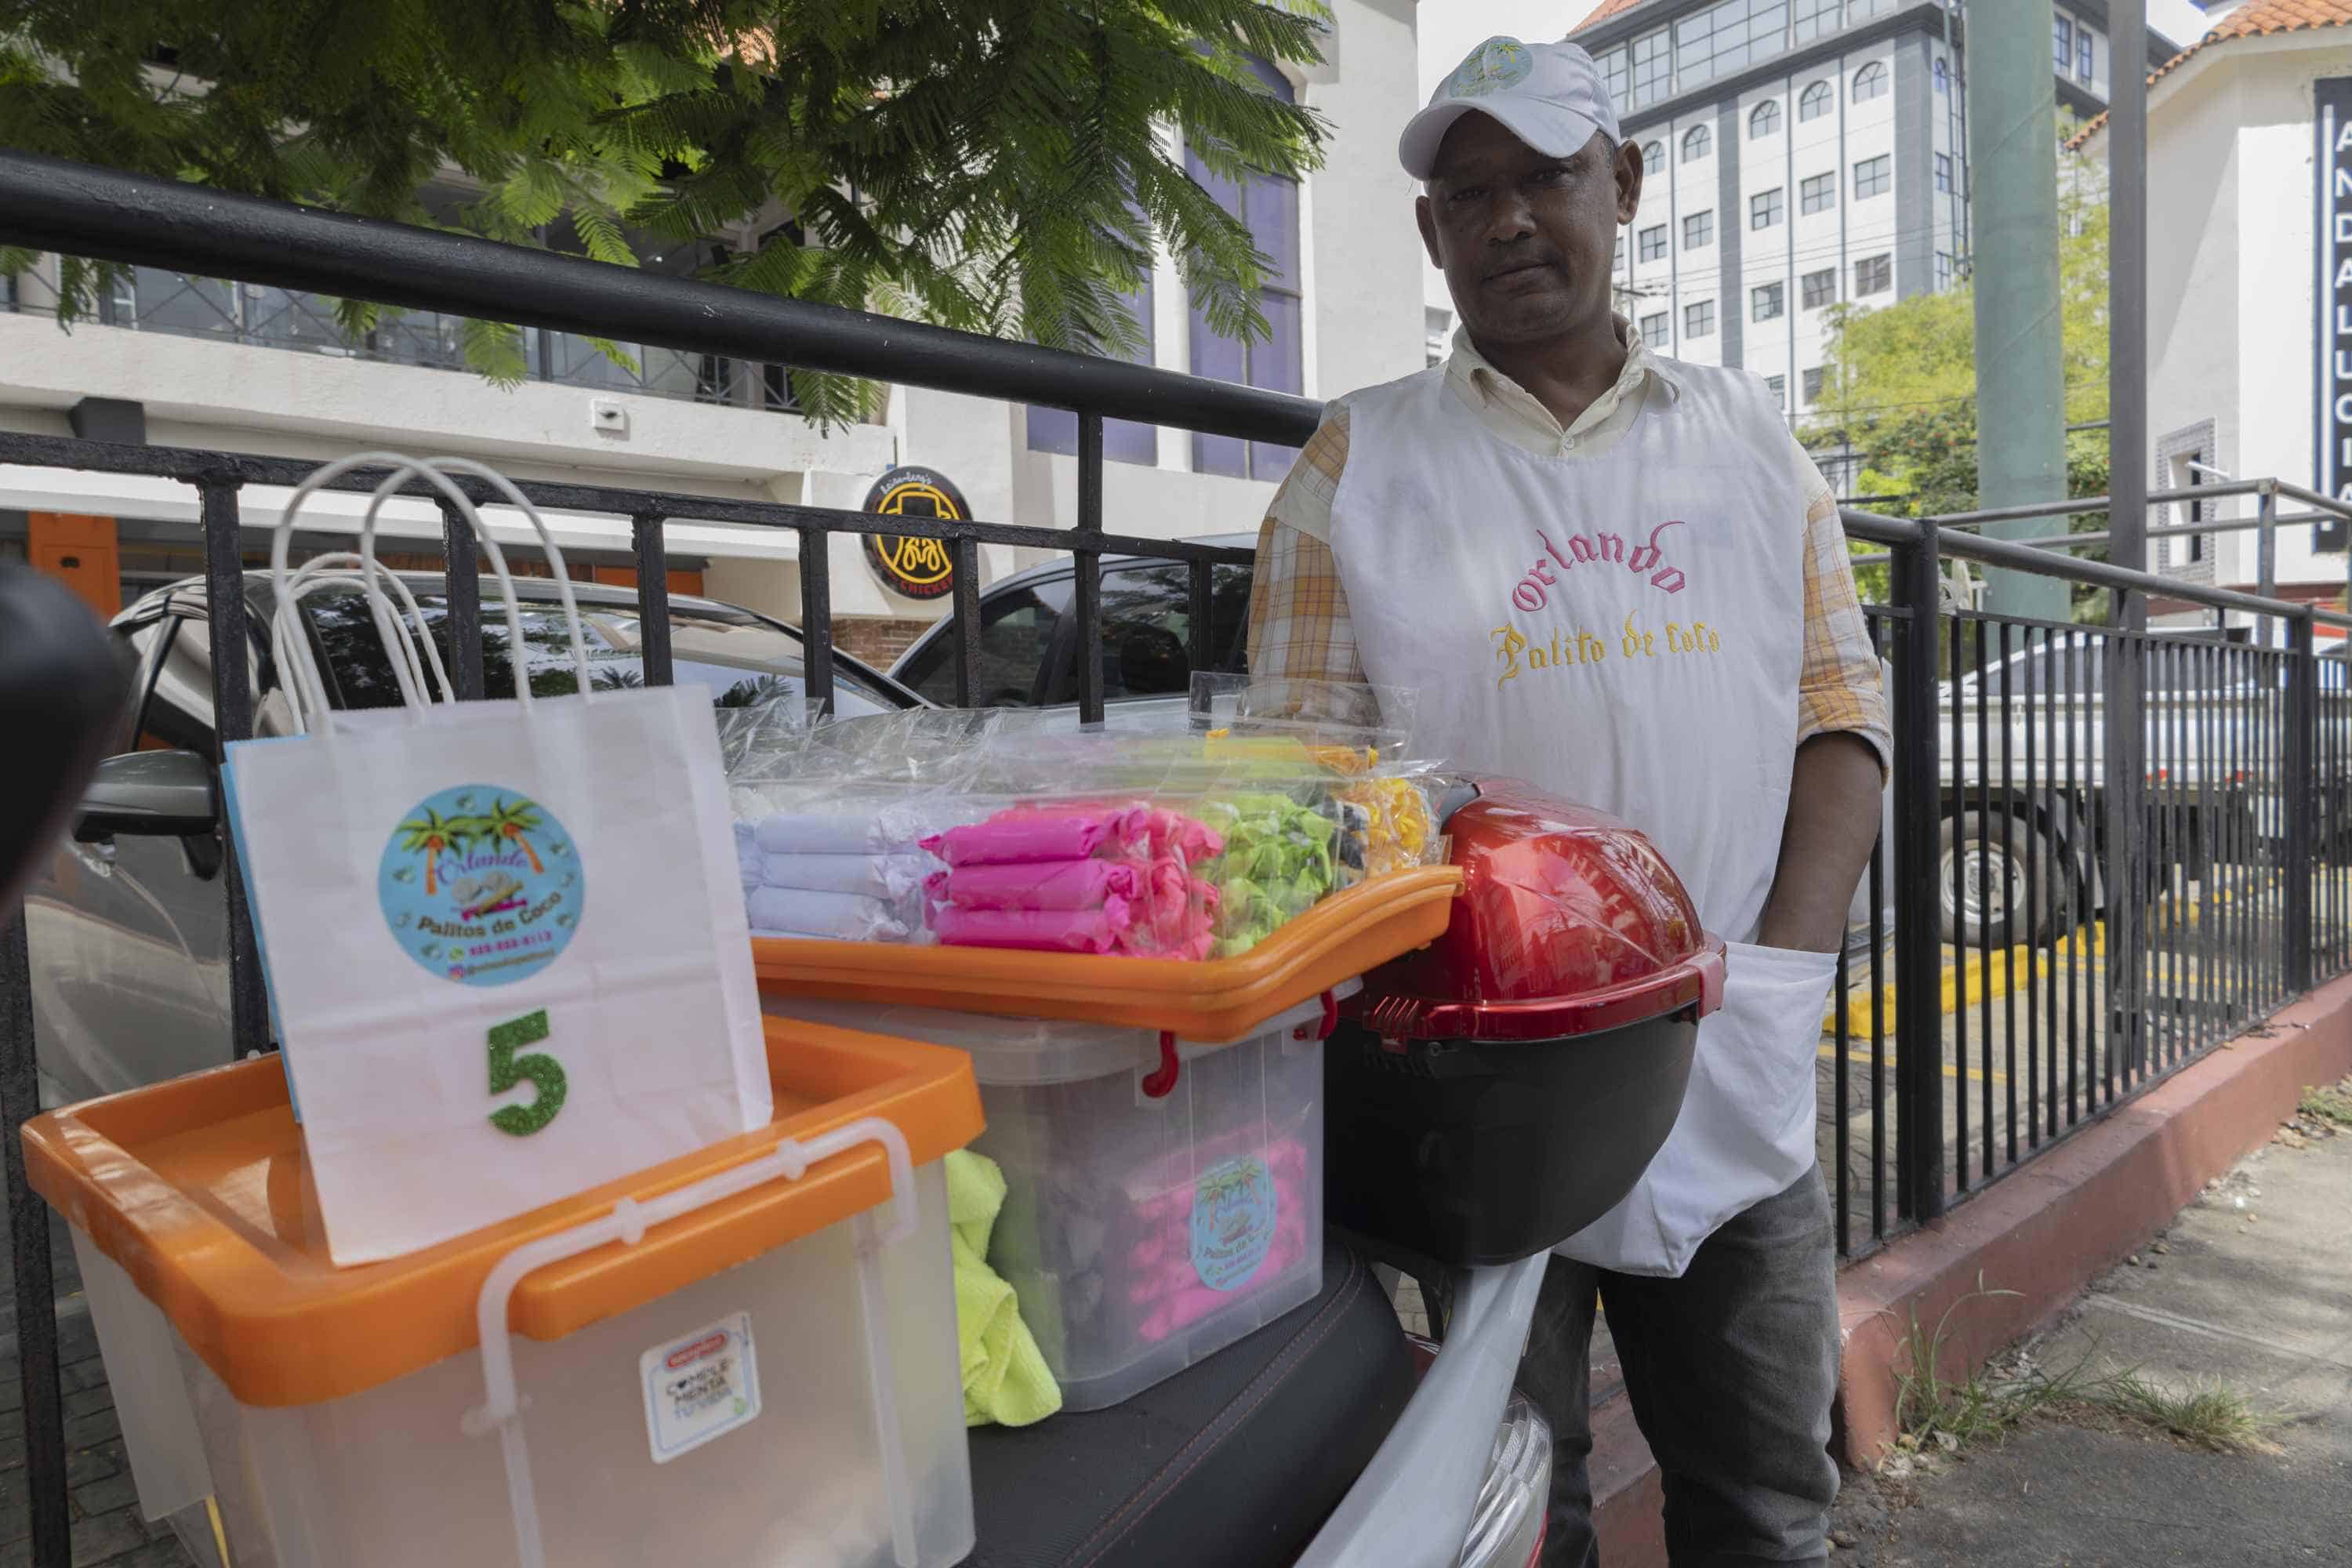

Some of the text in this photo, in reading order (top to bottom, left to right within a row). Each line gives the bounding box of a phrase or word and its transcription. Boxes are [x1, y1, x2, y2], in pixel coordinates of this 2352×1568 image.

[1512, 521, 1686, 612] Orlando
[1490, 622, 1607, 691] Palito
[1622, 608, 1656, 659] de
[417, 891, 562, 938] Palitos de Coco
[488, 1009, 567, 1137] 5
